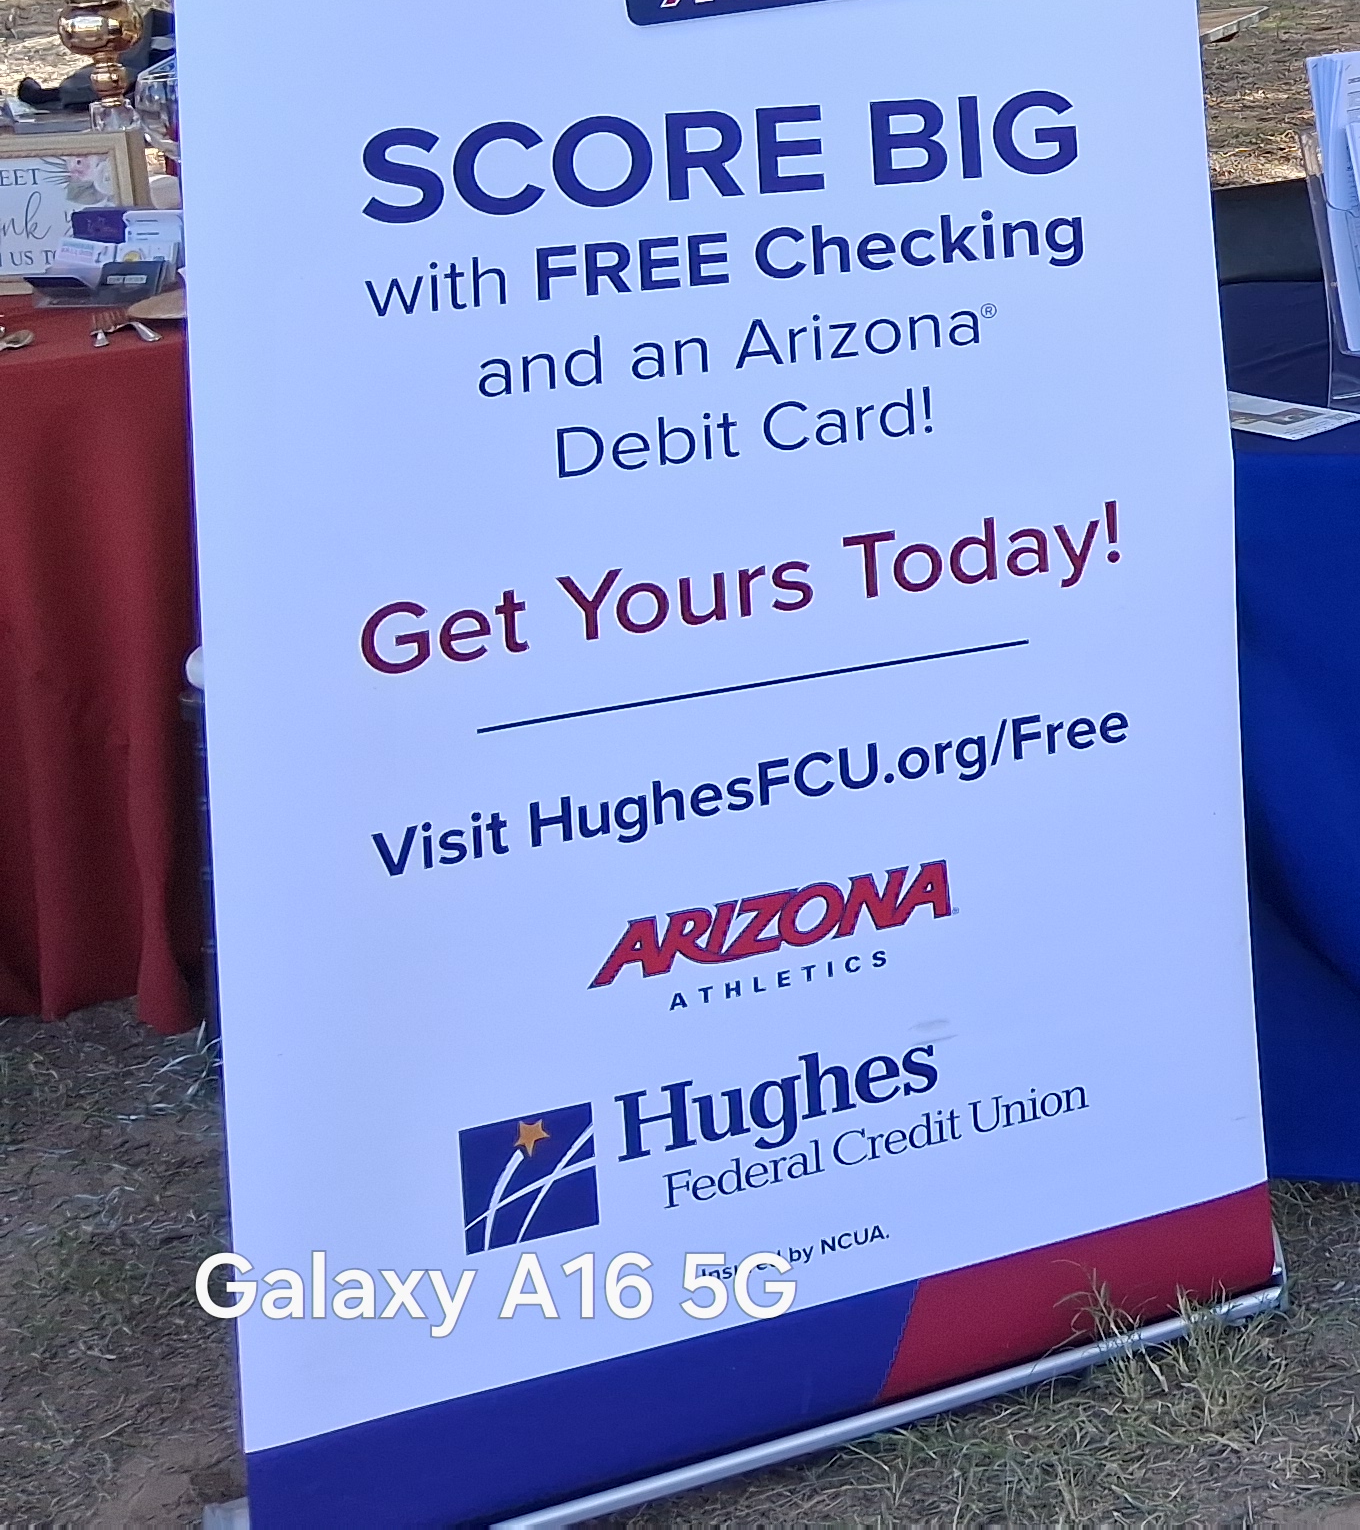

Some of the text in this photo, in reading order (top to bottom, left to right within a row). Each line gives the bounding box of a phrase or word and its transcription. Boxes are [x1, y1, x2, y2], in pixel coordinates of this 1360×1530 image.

[362, 90, 1079, 225] SCORE BIG
[10, 250, 34, 266] US
[364, 209, 1085, 317] with FREE Checking
[478, 336, 602, 399] and
[630, 334, 710, 381] an
[556, 386, 934, 479] Debit Card!
[361, 500, 1121, 674] Get Yours Today!
[372, 711, 1130, 877] Visit HughesFCU.org/Free
[587, 858, 953, 990] ARIZONA
[668, 948, 889, 1012] ATHLETICS
[613, 1042, 940, 1162] Hughes
[662, 1079, 1090, 1210] Federal Credit Union
[789, 1246, 814, 1264] by
[820, 1225, 890, 1255] NCUA.
